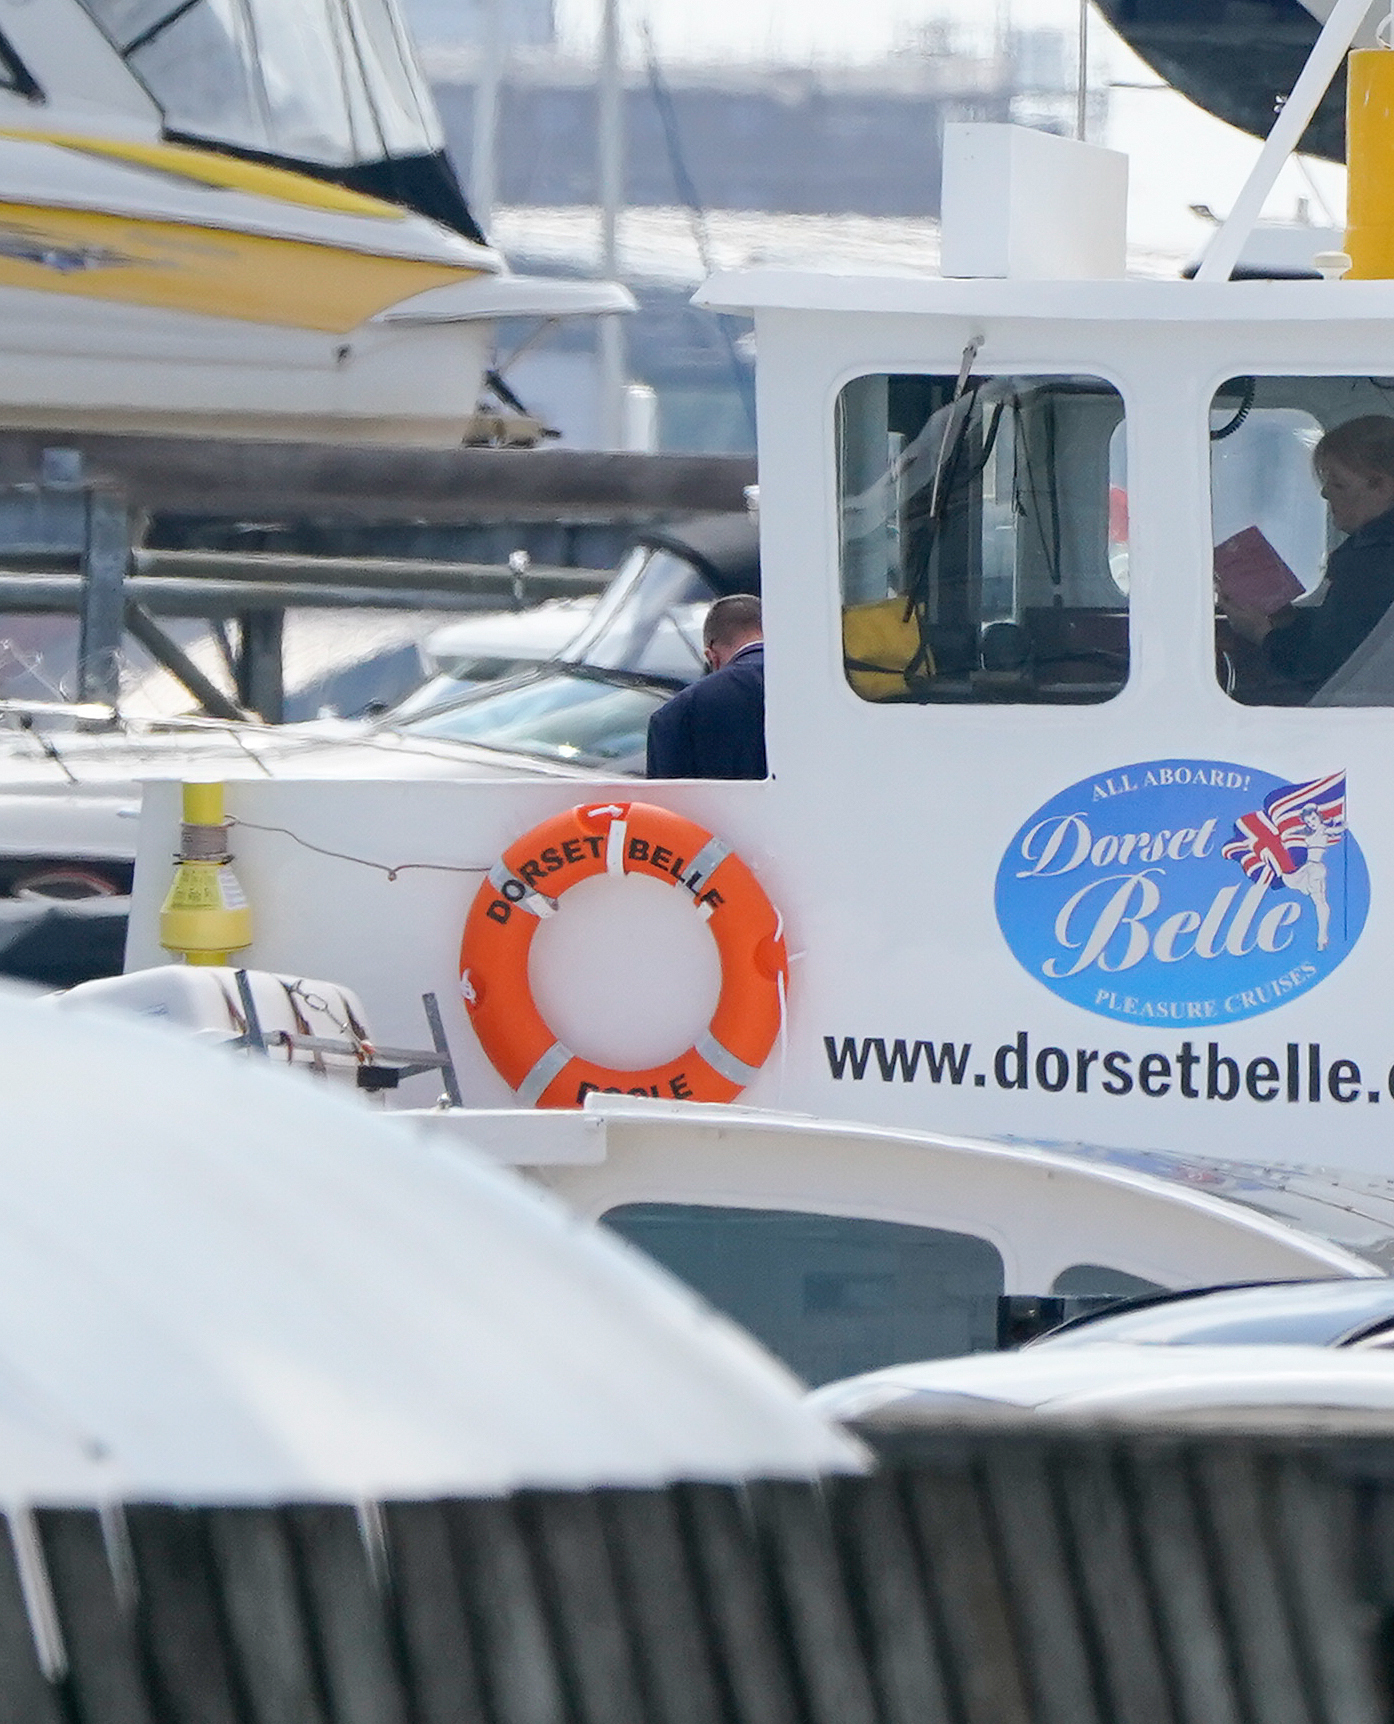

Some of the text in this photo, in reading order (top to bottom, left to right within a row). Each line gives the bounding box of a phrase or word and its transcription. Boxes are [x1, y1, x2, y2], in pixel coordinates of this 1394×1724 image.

[1093, 766, 1252, 802] ALL ABOARD!
[1015, 811, 1218, 879] Dorset
[486, 835, 726, 924] DORSET BELLE
[1041, 868, 1302, 979] Belle
[1095, 960, 1318, 1020] PLEASURE CRUISES
